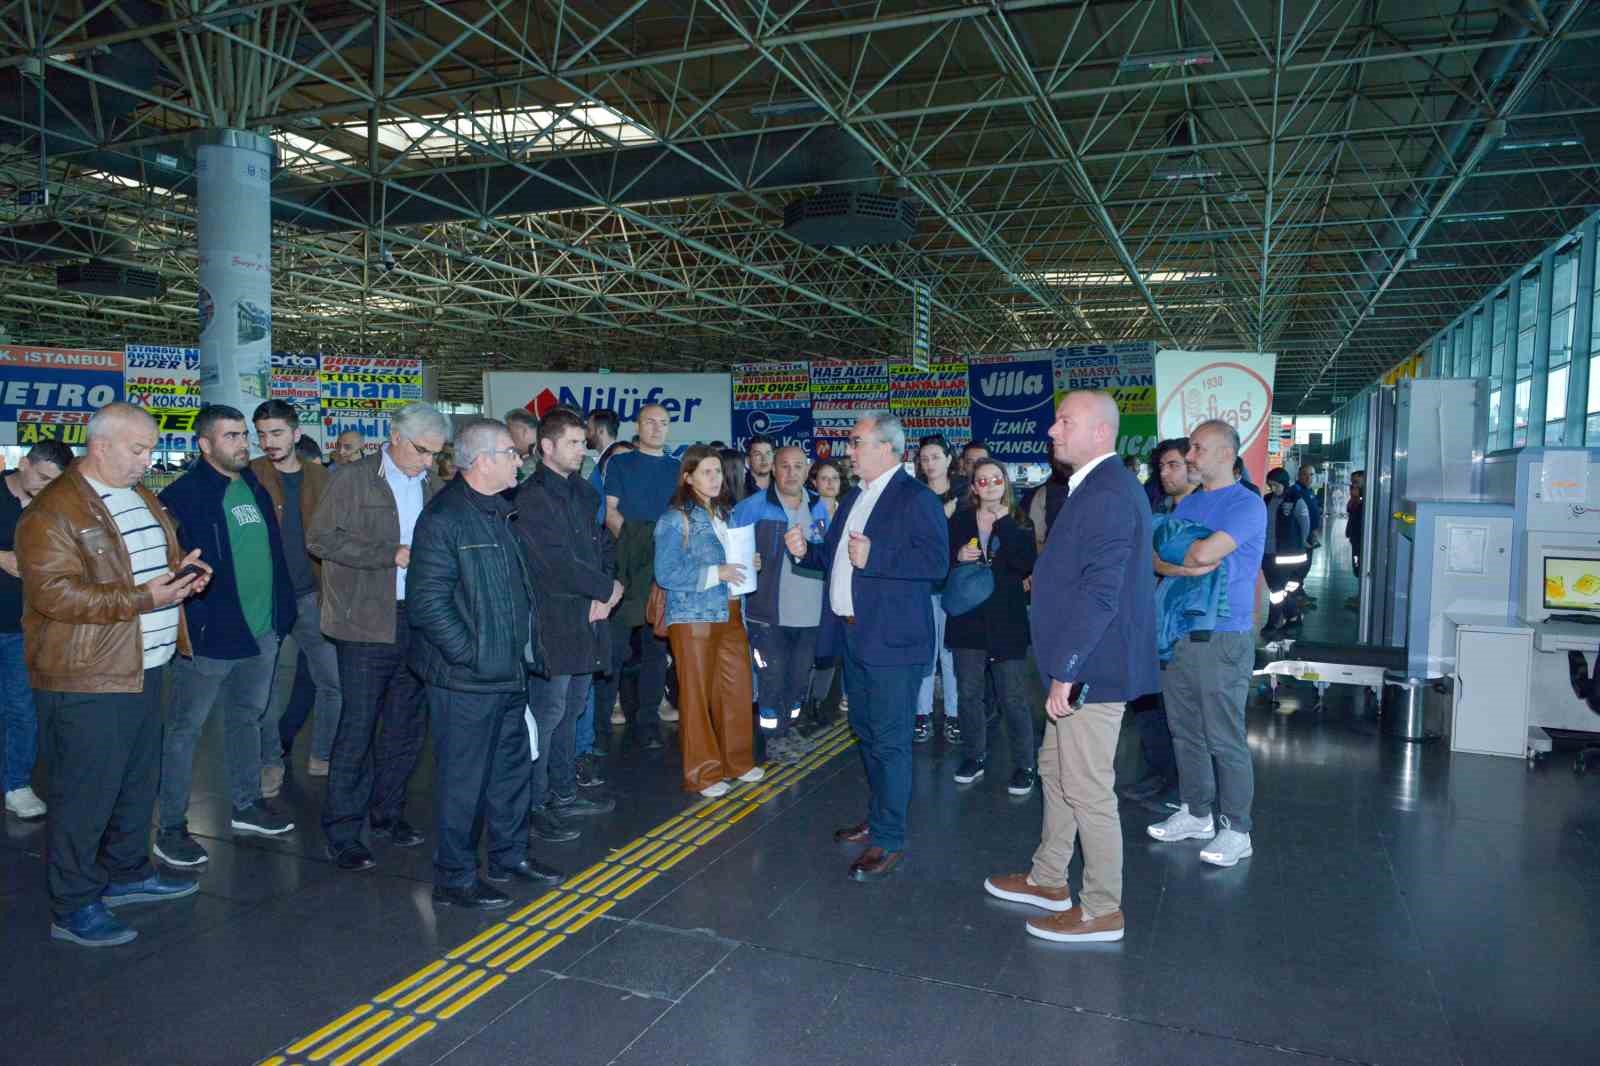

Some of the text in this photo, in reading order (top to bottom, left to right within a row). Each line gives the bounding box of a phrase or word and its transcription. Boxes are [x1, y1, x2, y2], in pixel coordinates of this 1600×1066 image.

[980, 370, 1044, 397] Villa
[1117, 375, 1153, 387] VAN
[0, 381, 115, 407] ETRO
[559, 386, 703, 423] Nilüfer
[992, 418, 1037, 434] İZMİR
[984, 437, 1048, 454] STANBUL
